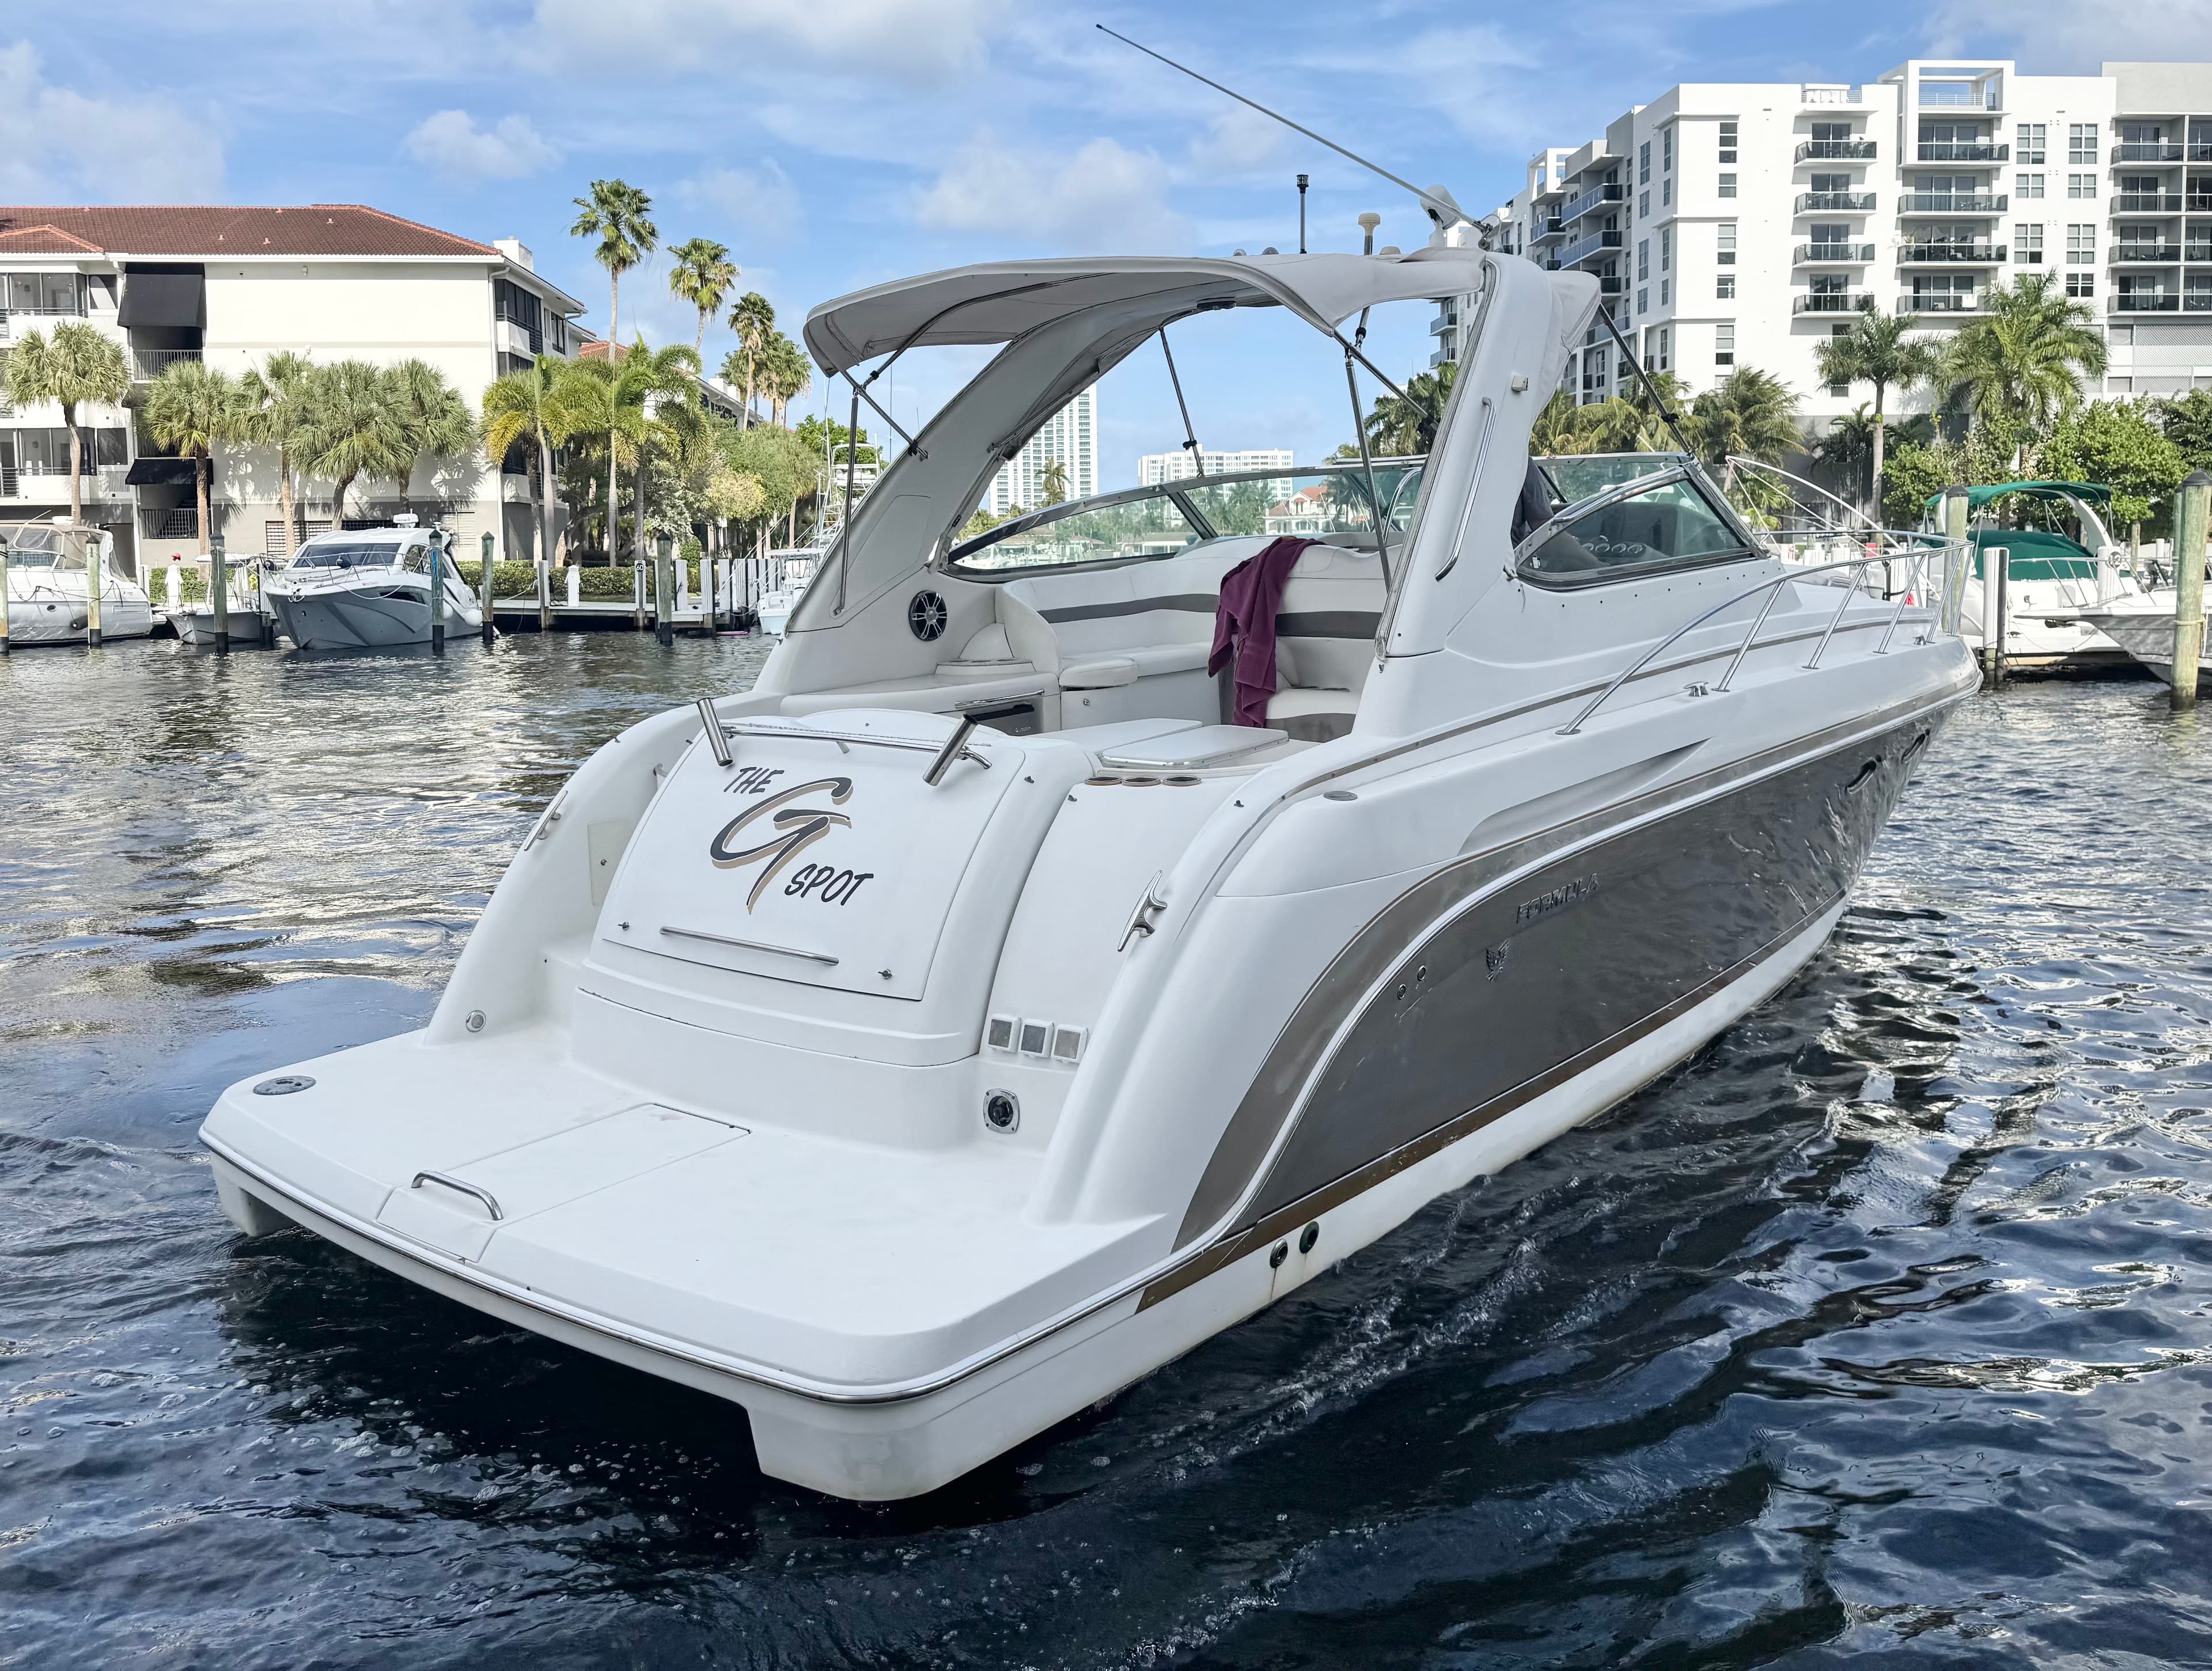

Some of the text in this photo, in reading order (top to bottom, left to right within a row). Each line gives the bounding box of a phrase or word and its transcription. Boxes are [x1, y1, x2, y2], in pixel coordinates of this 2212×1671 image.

[723, 767, 785, 794] THE
[710, 776, 854, 915] G
[784, 863, 874, 906] SPOT
[1516, 873, 1600, 923] FORMULA
